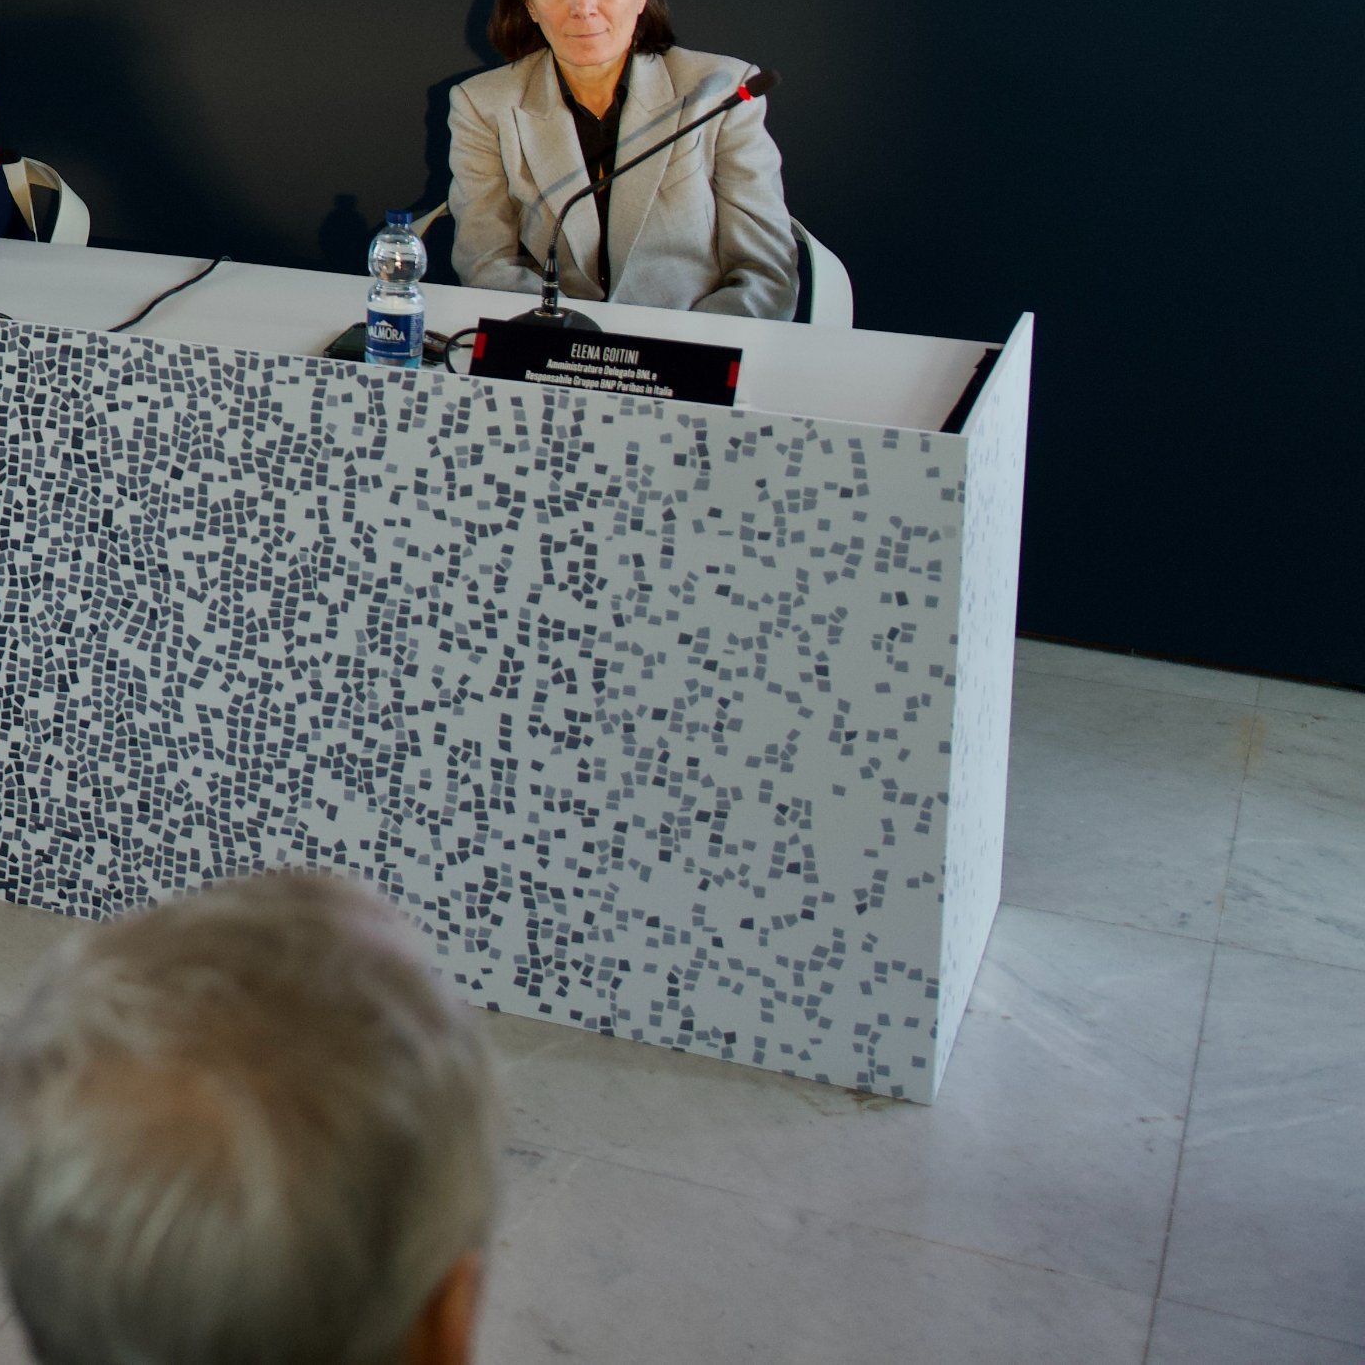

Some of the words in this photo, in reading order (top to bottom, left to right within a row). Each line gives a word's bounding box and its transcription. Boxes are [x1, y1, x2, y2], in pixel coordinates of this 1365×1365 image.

[571, 343, 600, 360] ELENA
[603, 347, 640, 365] GOITINI
[546, 358, 603, 374] Amministratore
[604, 365, 635, 379] Delegato
[635, 369, 651, 380] BNL
[525, 370, 573, 385] Responsabile
[573, 375, 599, 390] Gruppo
[600, 378, 617, 390] BNP
[616, 380, 645, 393] Paribas
[653, 386, 673, 397] Italia
